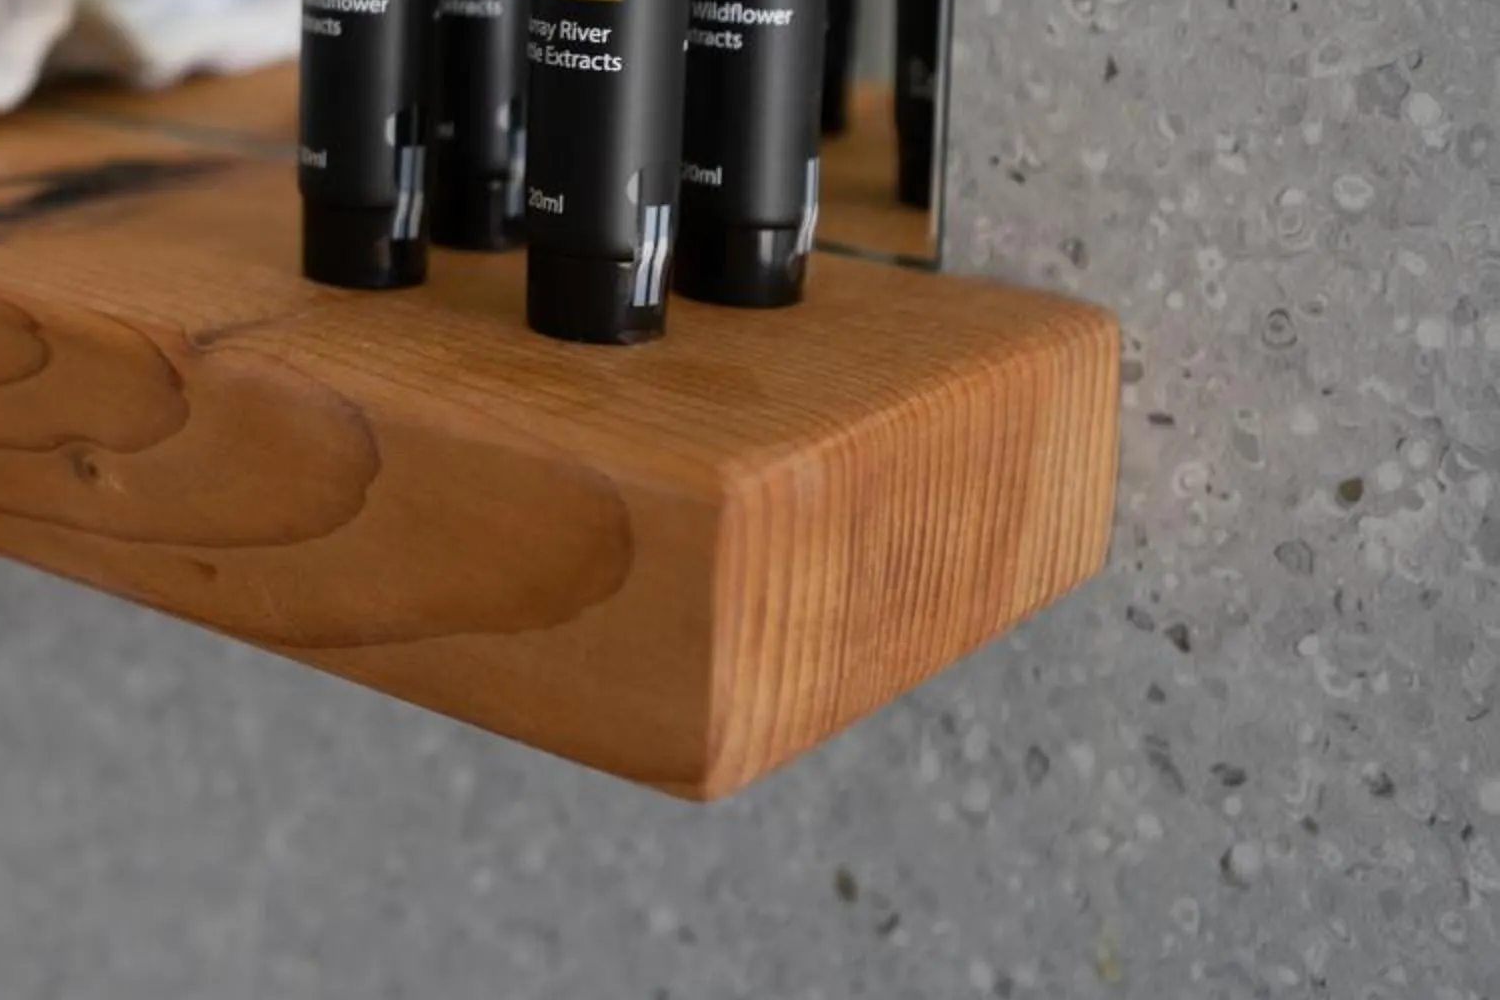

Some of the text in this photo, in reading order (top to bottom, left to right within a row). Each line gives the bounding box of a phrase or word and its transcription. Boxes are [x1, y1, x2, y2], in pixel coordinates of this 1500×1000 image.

[692, 0, 794, 26] Wildflower
[560, 19, 612, 44] River
[545, 45, 623, 72] Extracts
[528, 186, 565, 215] 20ml
